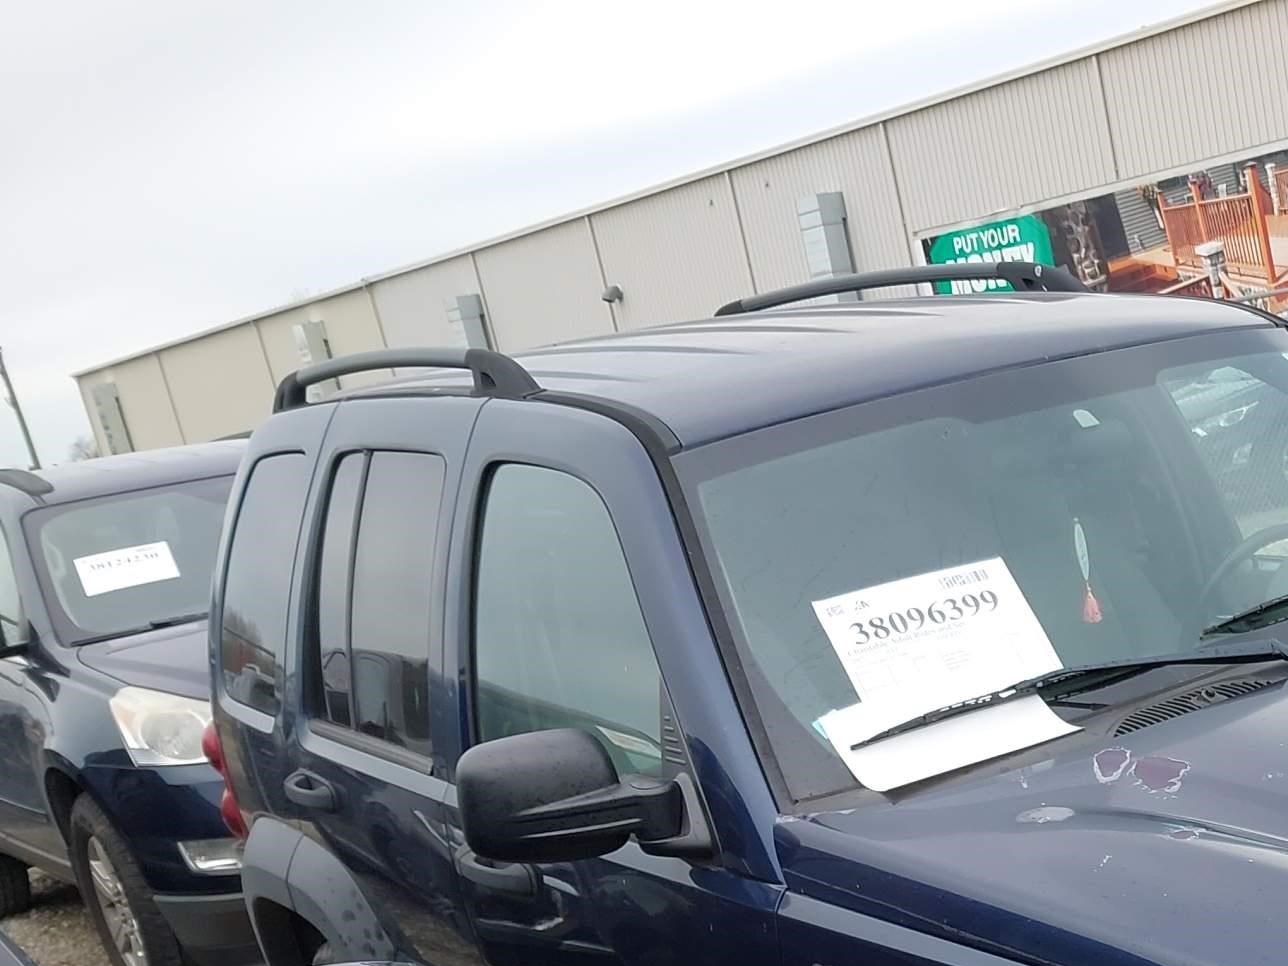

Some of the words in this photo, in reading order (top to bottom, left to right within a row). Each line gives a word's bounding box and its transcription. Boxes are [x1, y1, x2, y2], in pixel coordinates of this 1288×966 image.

[953, 232, 980, 254] PUT
[980, 224, 1021, 248] YOUR
[849, 590, 999, 645] 38096399
